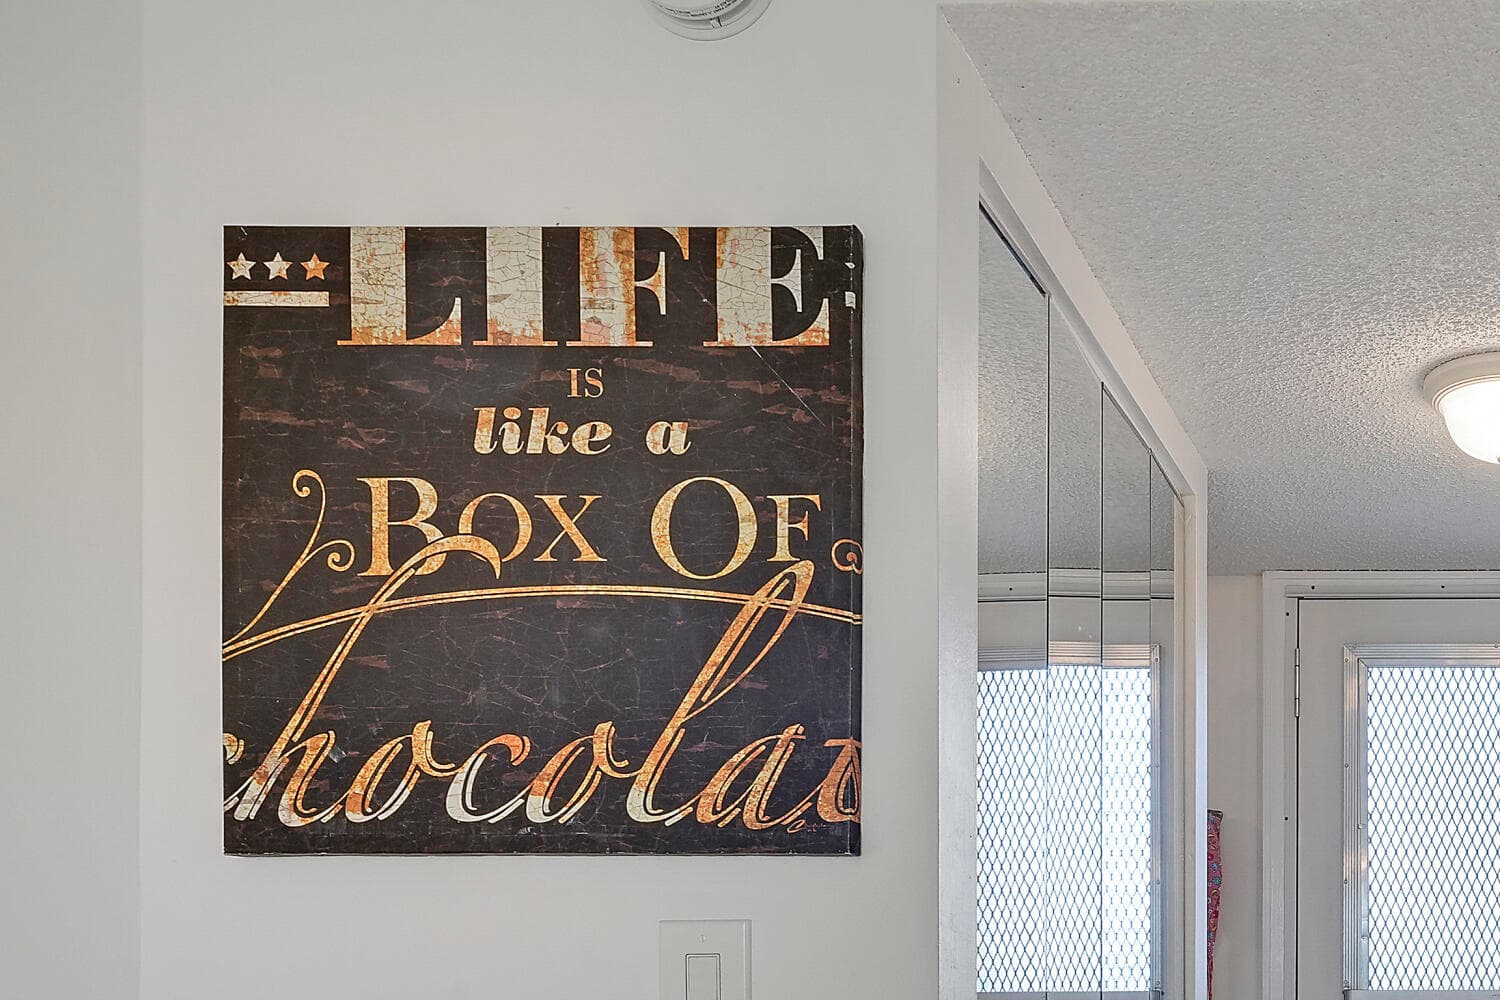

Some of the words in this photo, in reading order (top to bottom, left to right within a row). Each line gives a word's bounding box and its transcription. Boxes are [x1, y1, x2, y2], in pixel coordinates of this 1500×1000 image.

[336, 226, 830, 347] LIFE
[472, 406, 612, 454] like
[644, 420, 691, 455] a
[567, 368, 604, 398] IS
[650, 476, 822, 579] OF
[222, 532, 862, 828] hocola
